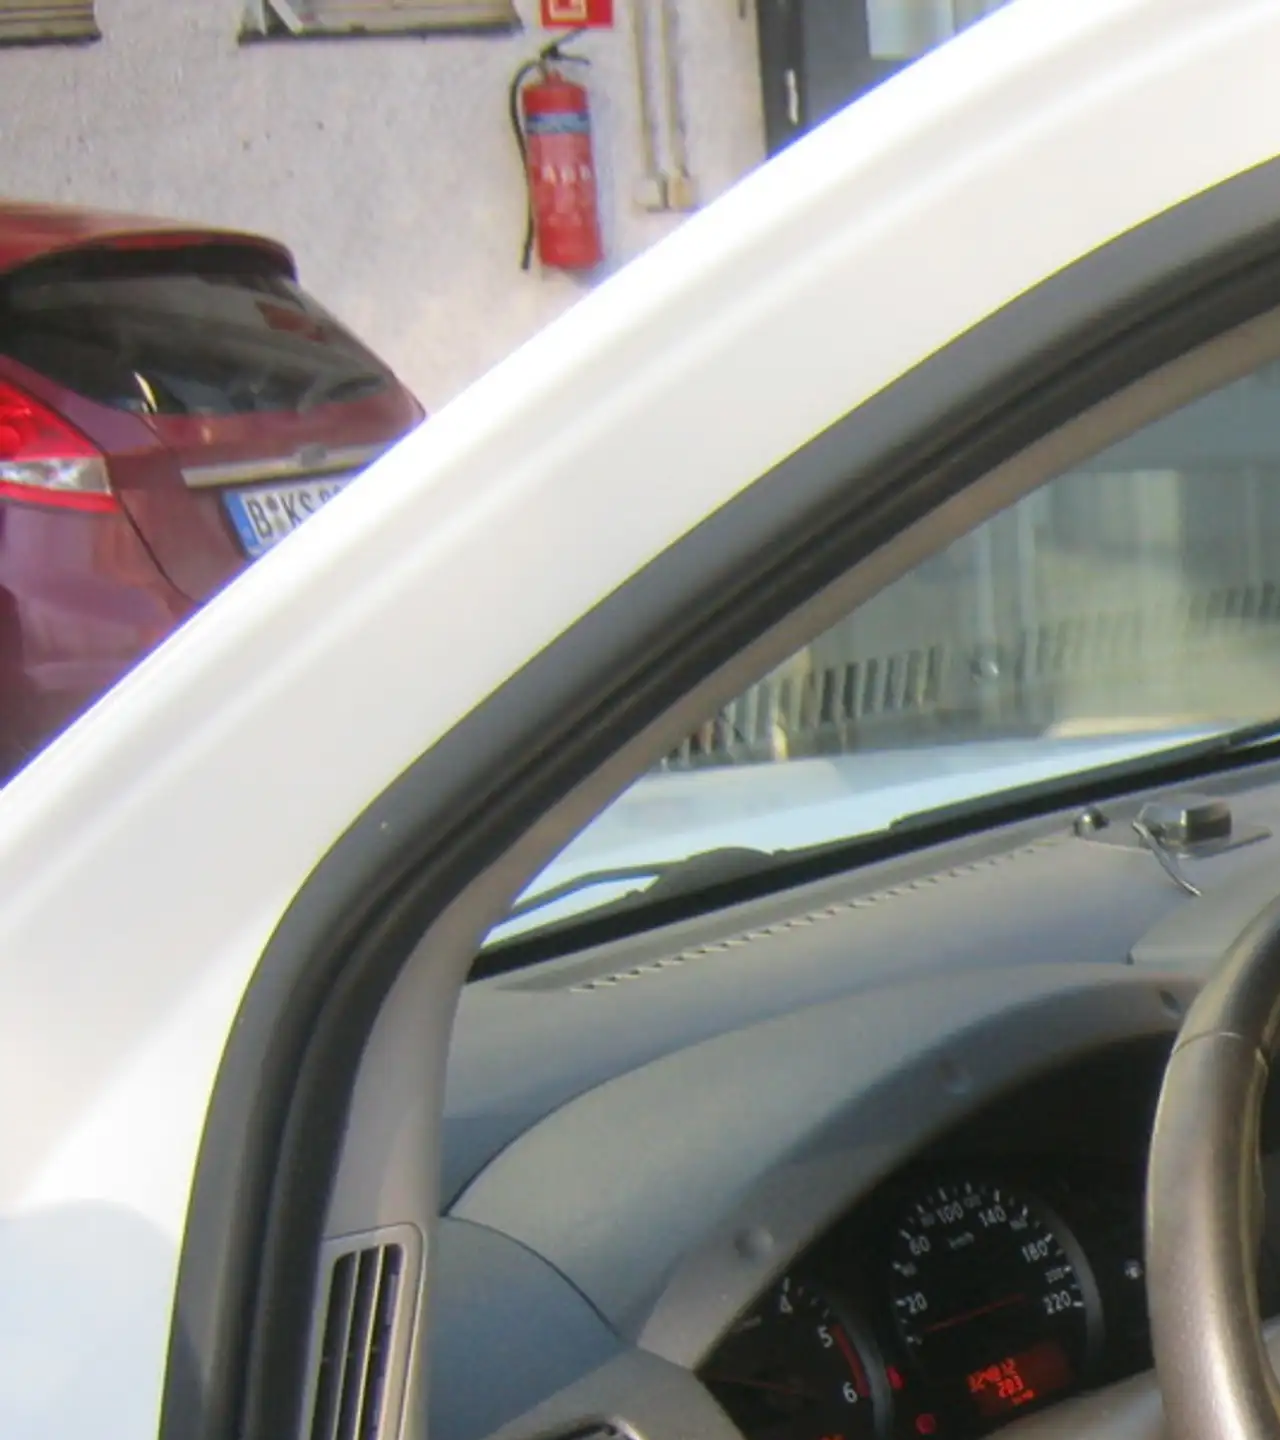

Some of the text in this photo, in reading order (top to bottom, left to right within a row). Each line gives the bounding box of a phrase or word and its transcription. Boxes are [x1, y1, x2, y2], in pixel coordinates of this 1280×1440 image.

[249, 498, 273, 539] B
[936, 1200, 964, 1225] 100
[978, 1204, 1007, 1229] 140
[909, 1235, 931, 1256] 60
[1021, 1239, 1048, 1264] 180
[905, 1291, 928, 1315] 20
[1042, 1289, 1071, 1316] 220
[817, 1325, 834, 1349] 5
[843, 1381, 858, 1404] 6
